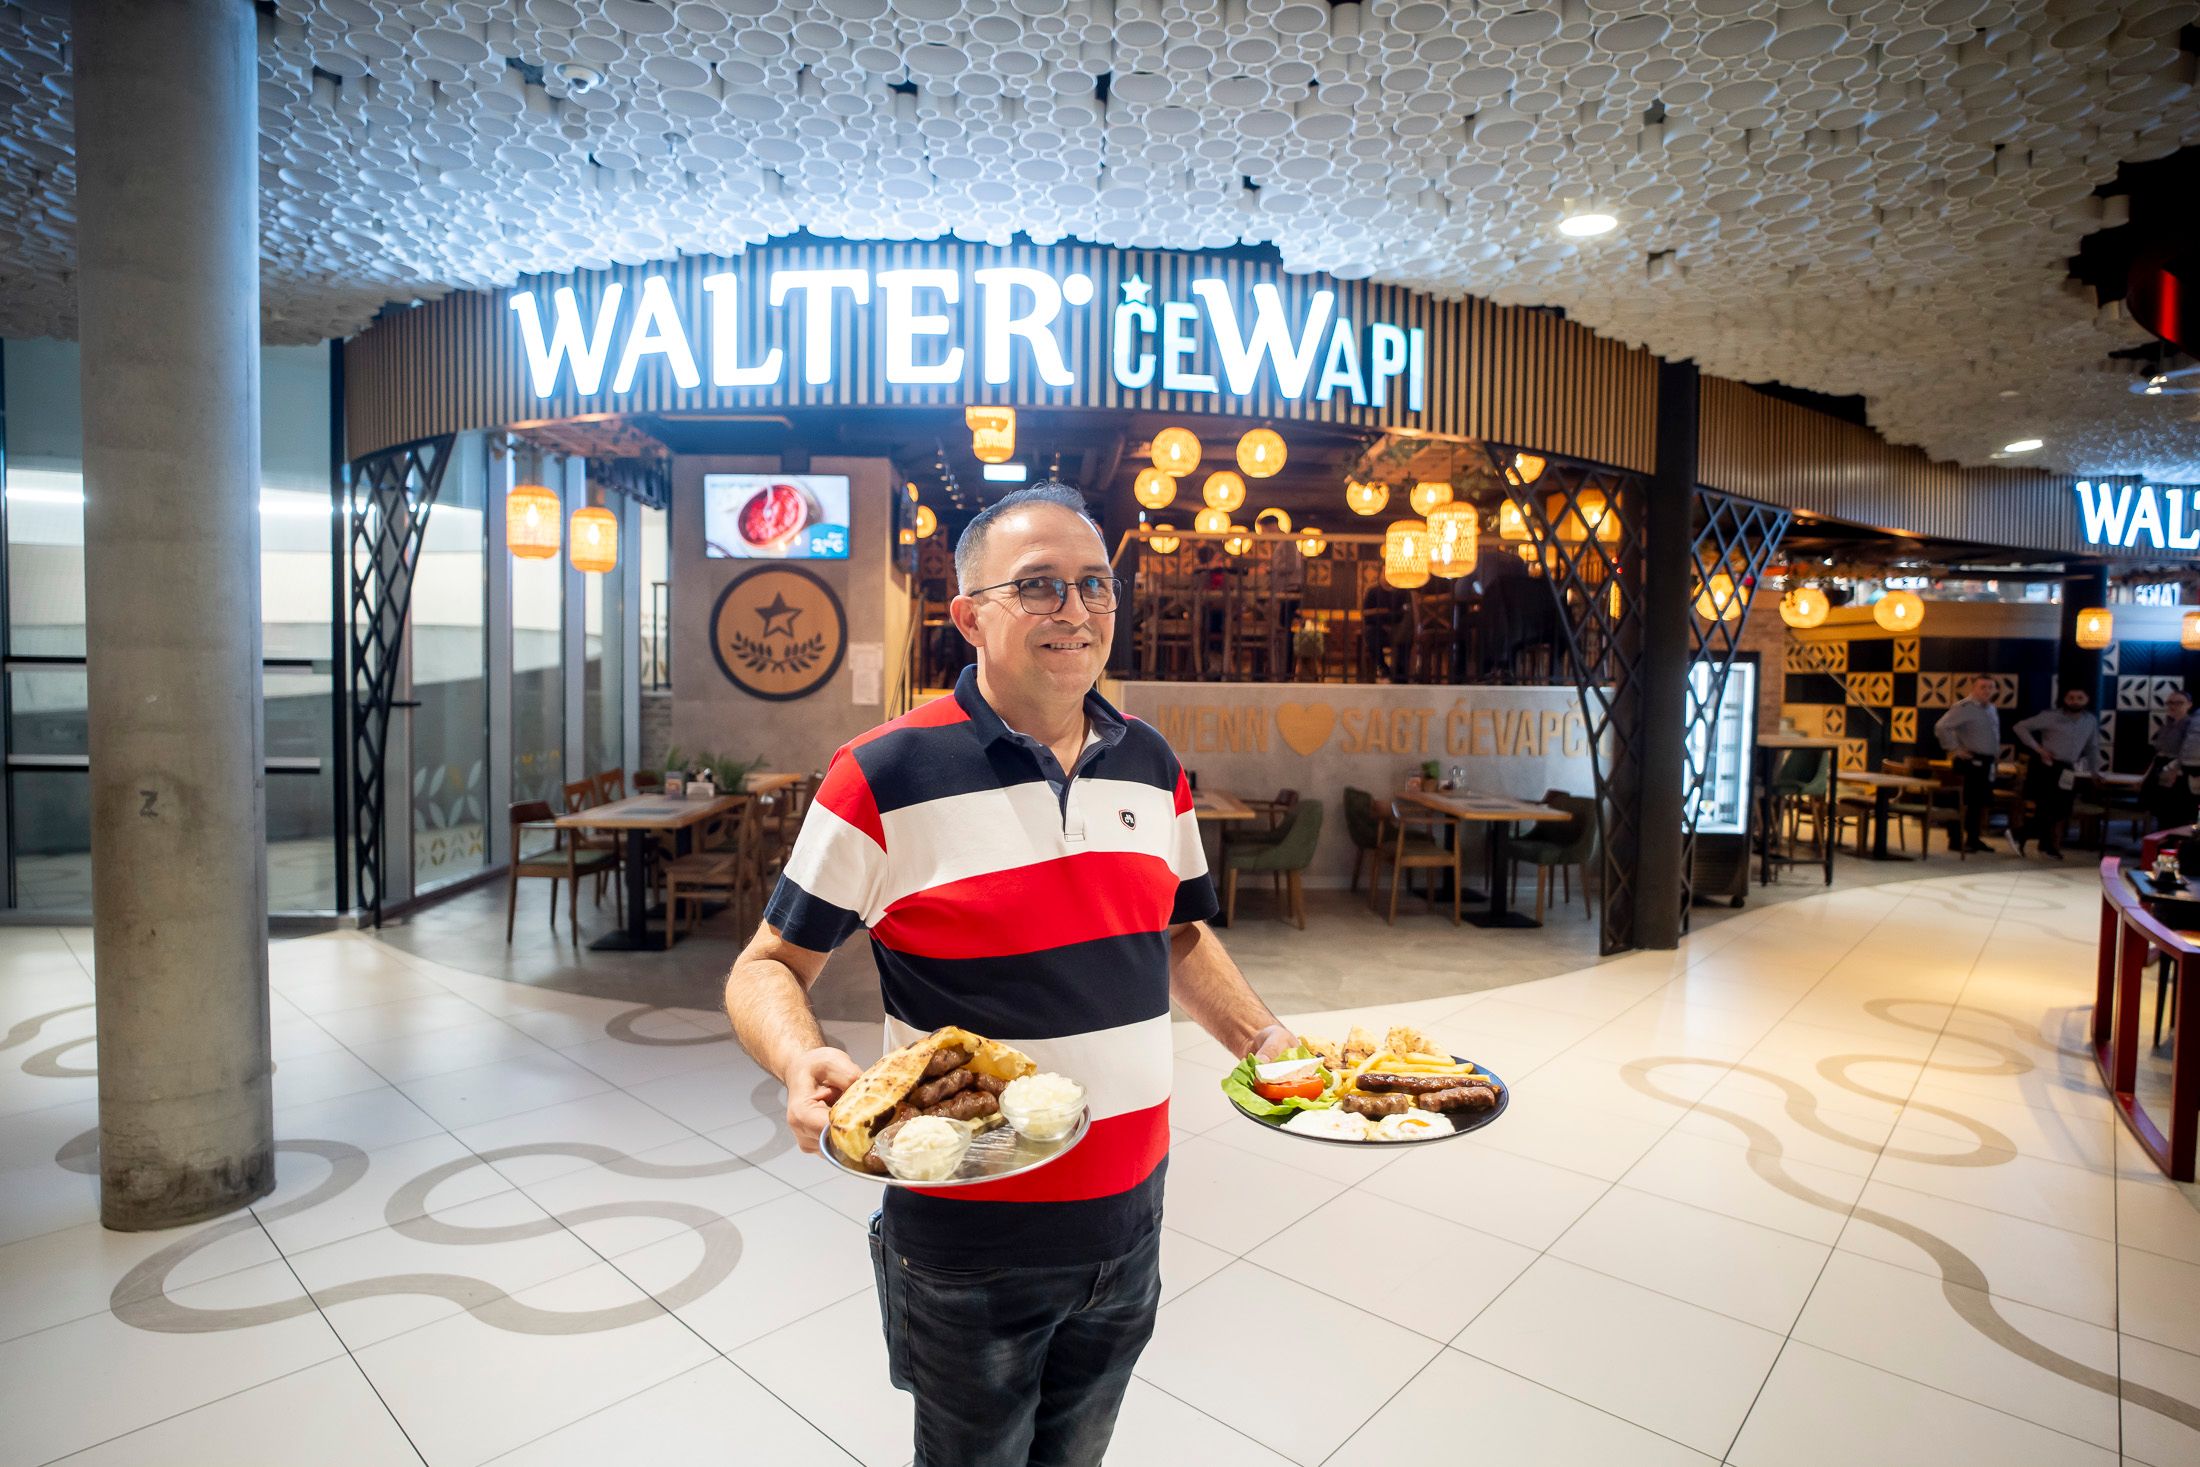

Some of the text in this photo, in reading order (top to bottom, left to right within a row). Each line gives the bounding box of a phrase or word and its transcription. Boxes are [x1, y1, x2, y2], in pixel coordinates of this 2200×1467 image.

[509, 266, 1075, 398] WALTER
[2075, 480, 2200, 550] WAL
[1157, 697, 1613, 758] WENN SAGT ĆEVAPČ
